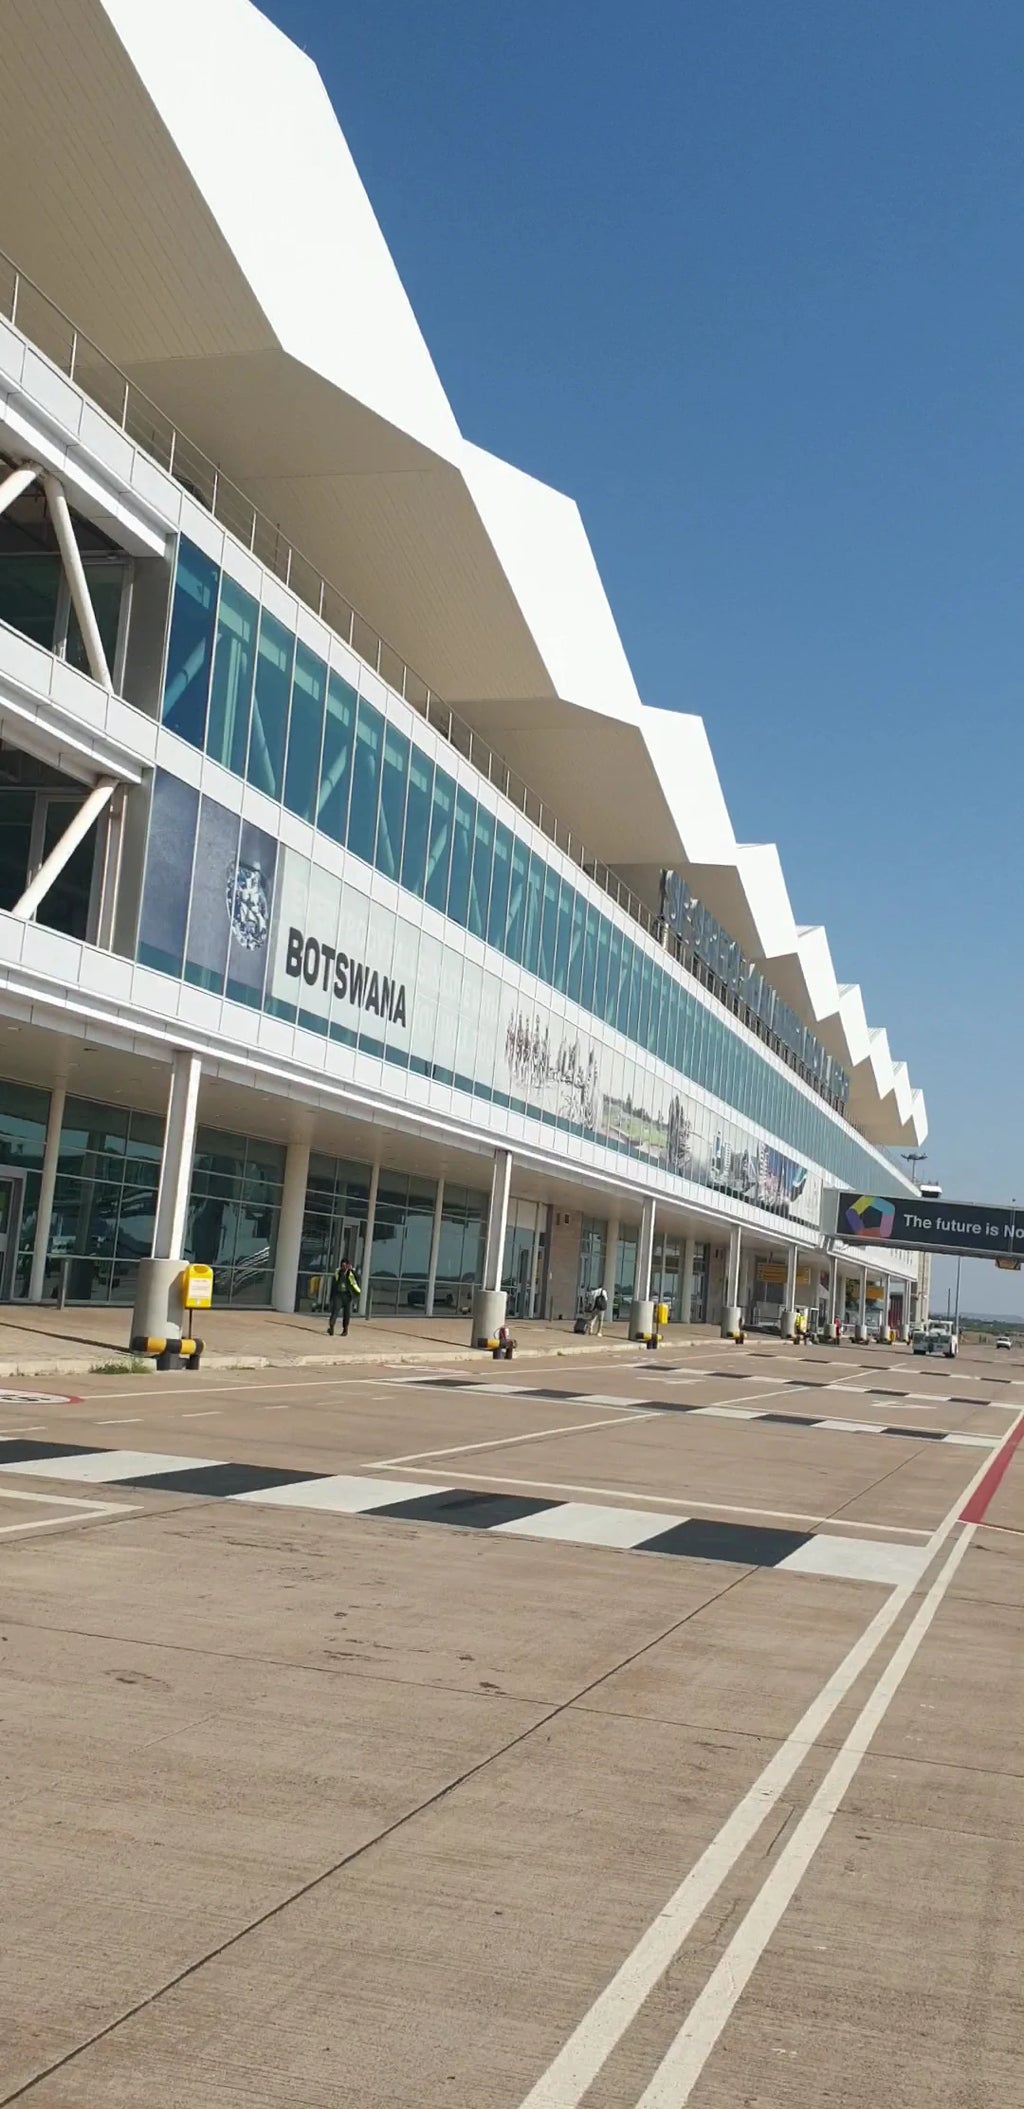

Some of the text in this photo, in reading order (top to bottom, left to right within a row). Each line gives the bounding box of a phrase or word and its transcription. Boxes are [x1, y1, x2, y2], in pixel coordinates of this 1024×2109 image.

[286, 926, 406, 1028] BOTSWANA
[903, 1213, 932, 1229] The
[936, 1217, 981, 1234] future
[985, 1222, 999, 1236] is
